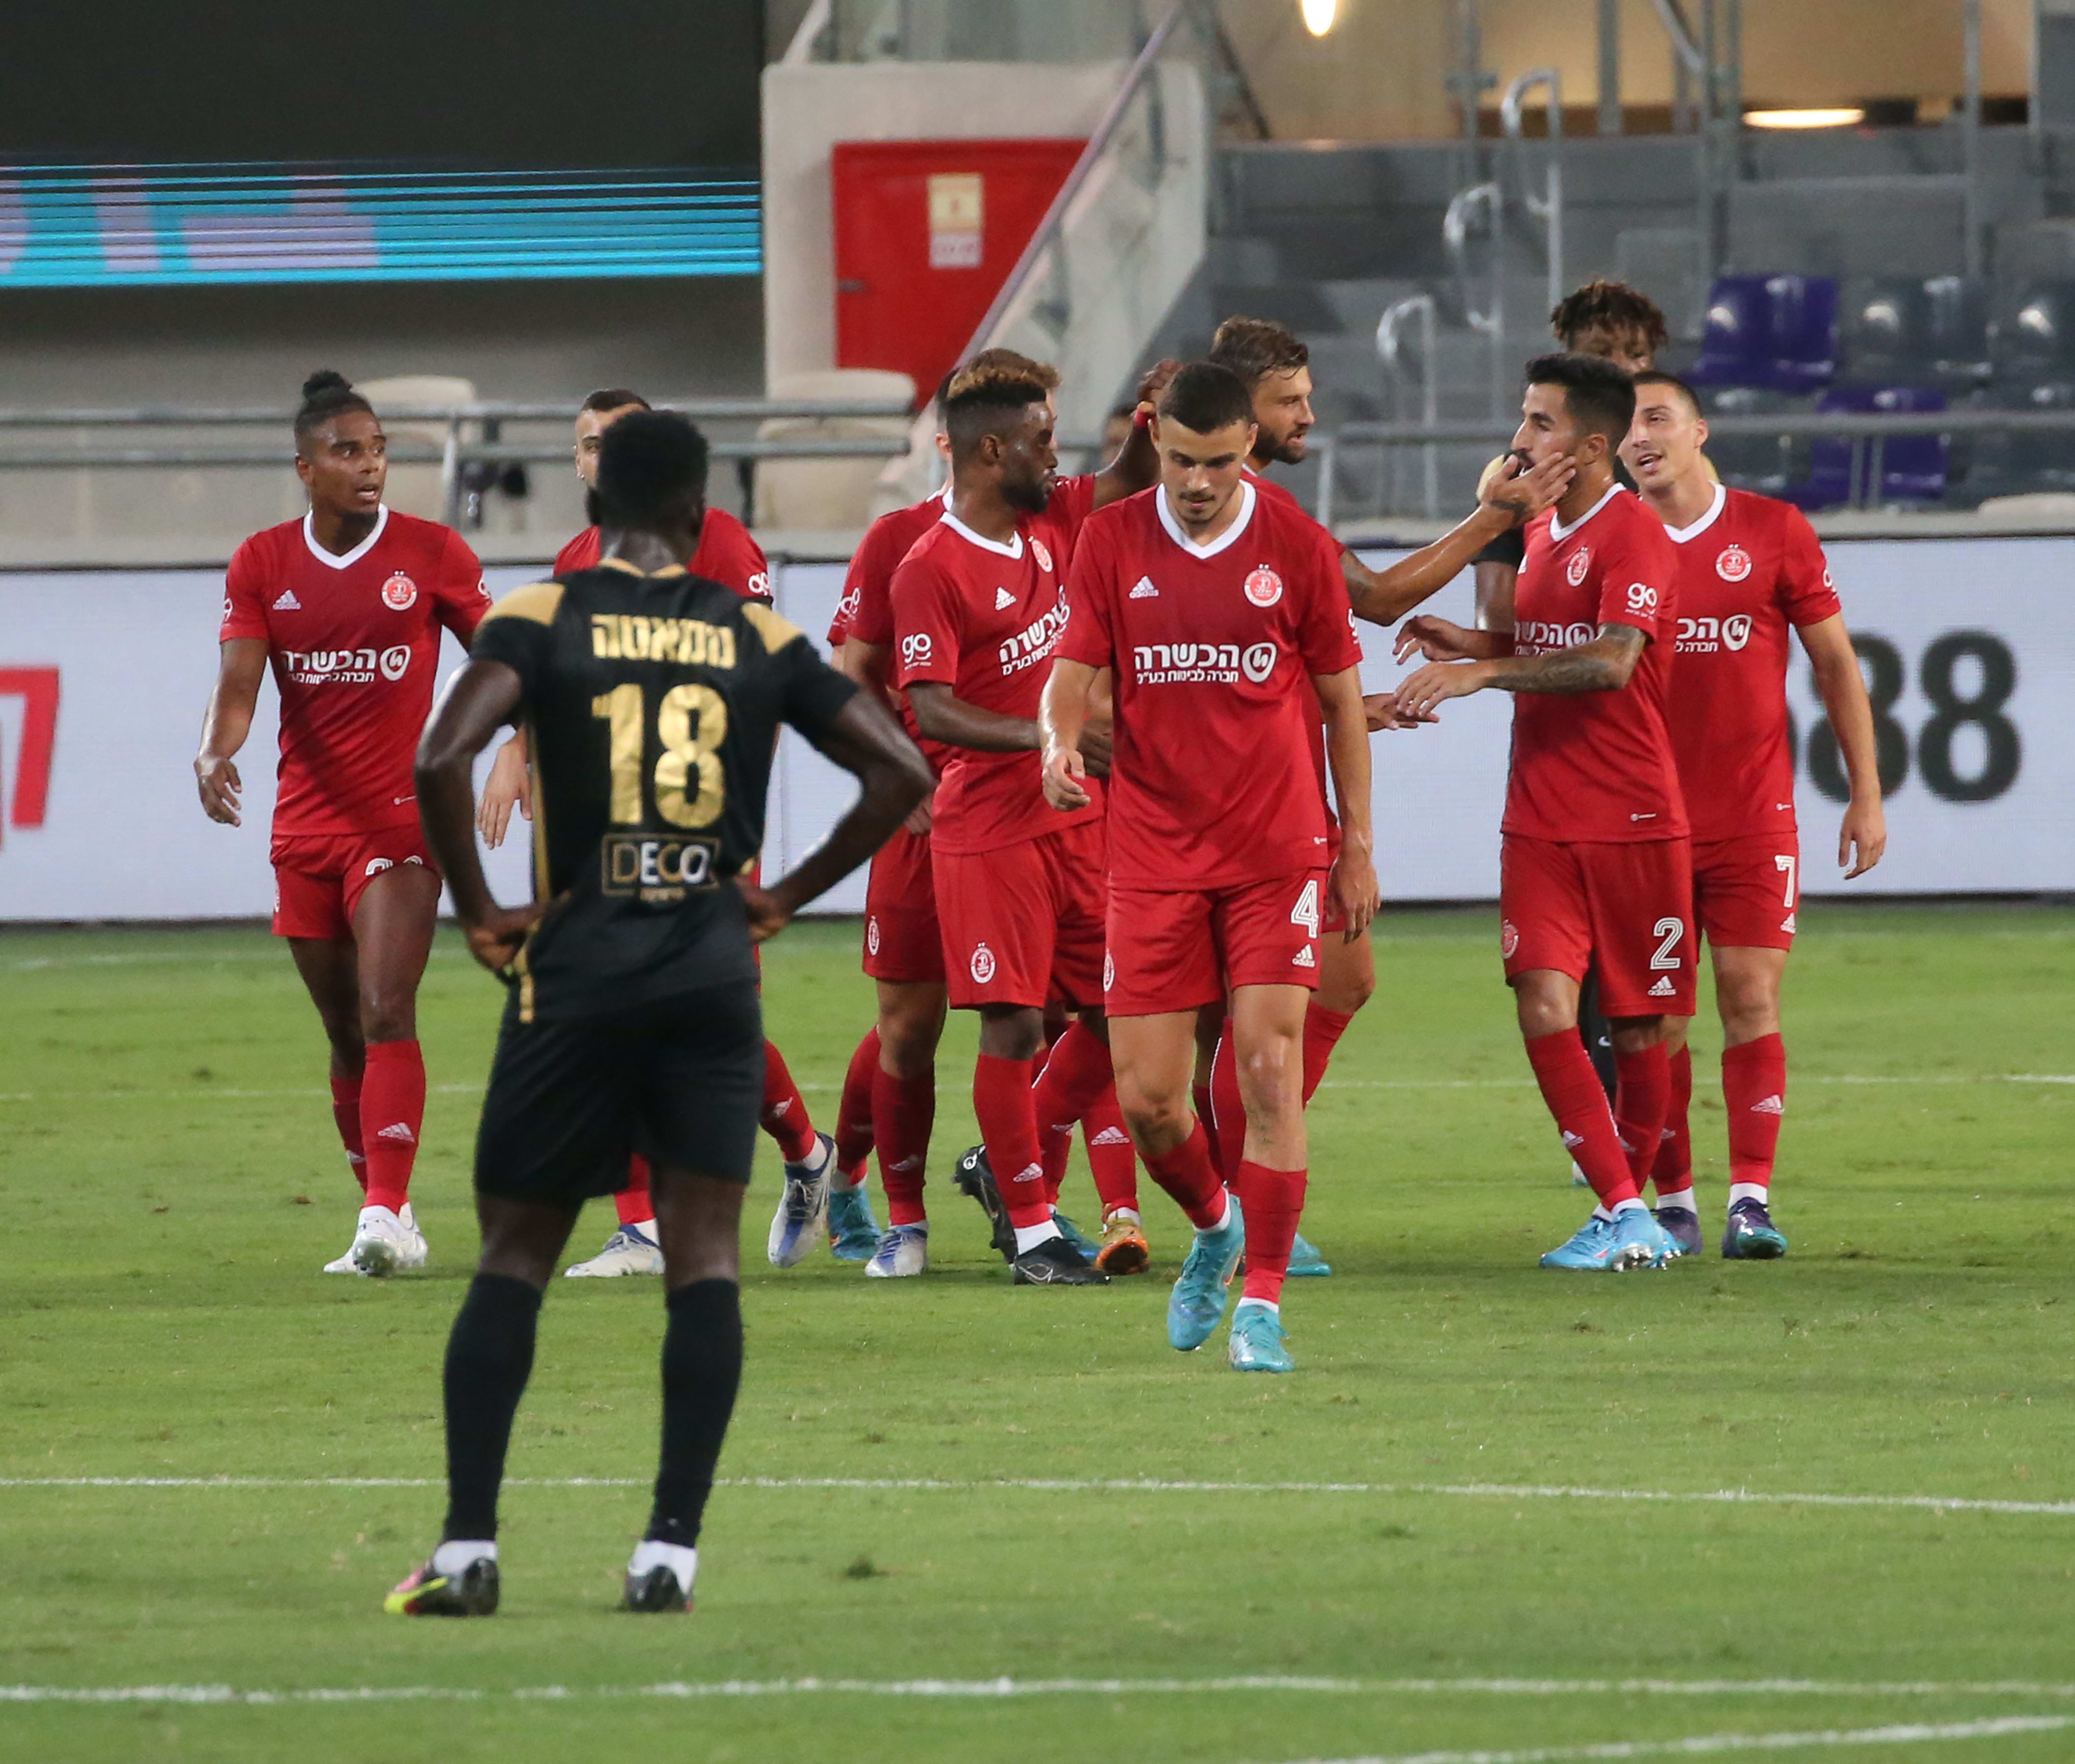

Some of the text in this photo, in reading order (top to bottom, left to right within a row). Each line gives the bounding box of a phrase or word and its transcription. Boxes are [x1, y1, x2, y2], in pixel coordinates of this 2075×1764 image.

[1627, 582, 1658, 609] go
[902, 632, 932, 664] go
[1133, 643, 1240, 670] הכשרה
[341, 672, 375, 683] חברה
[1207, 670, 1239, 683] חברה
[1788, 629, 2021, 803] 88
[591, 683, 727, 829] 18
[612, 841, 710, 885] DECO
[1775, 855, 1795, 908] 7
[1291, 880, 1319, 939] 4
[1650, 917, 1684, 970] 2
